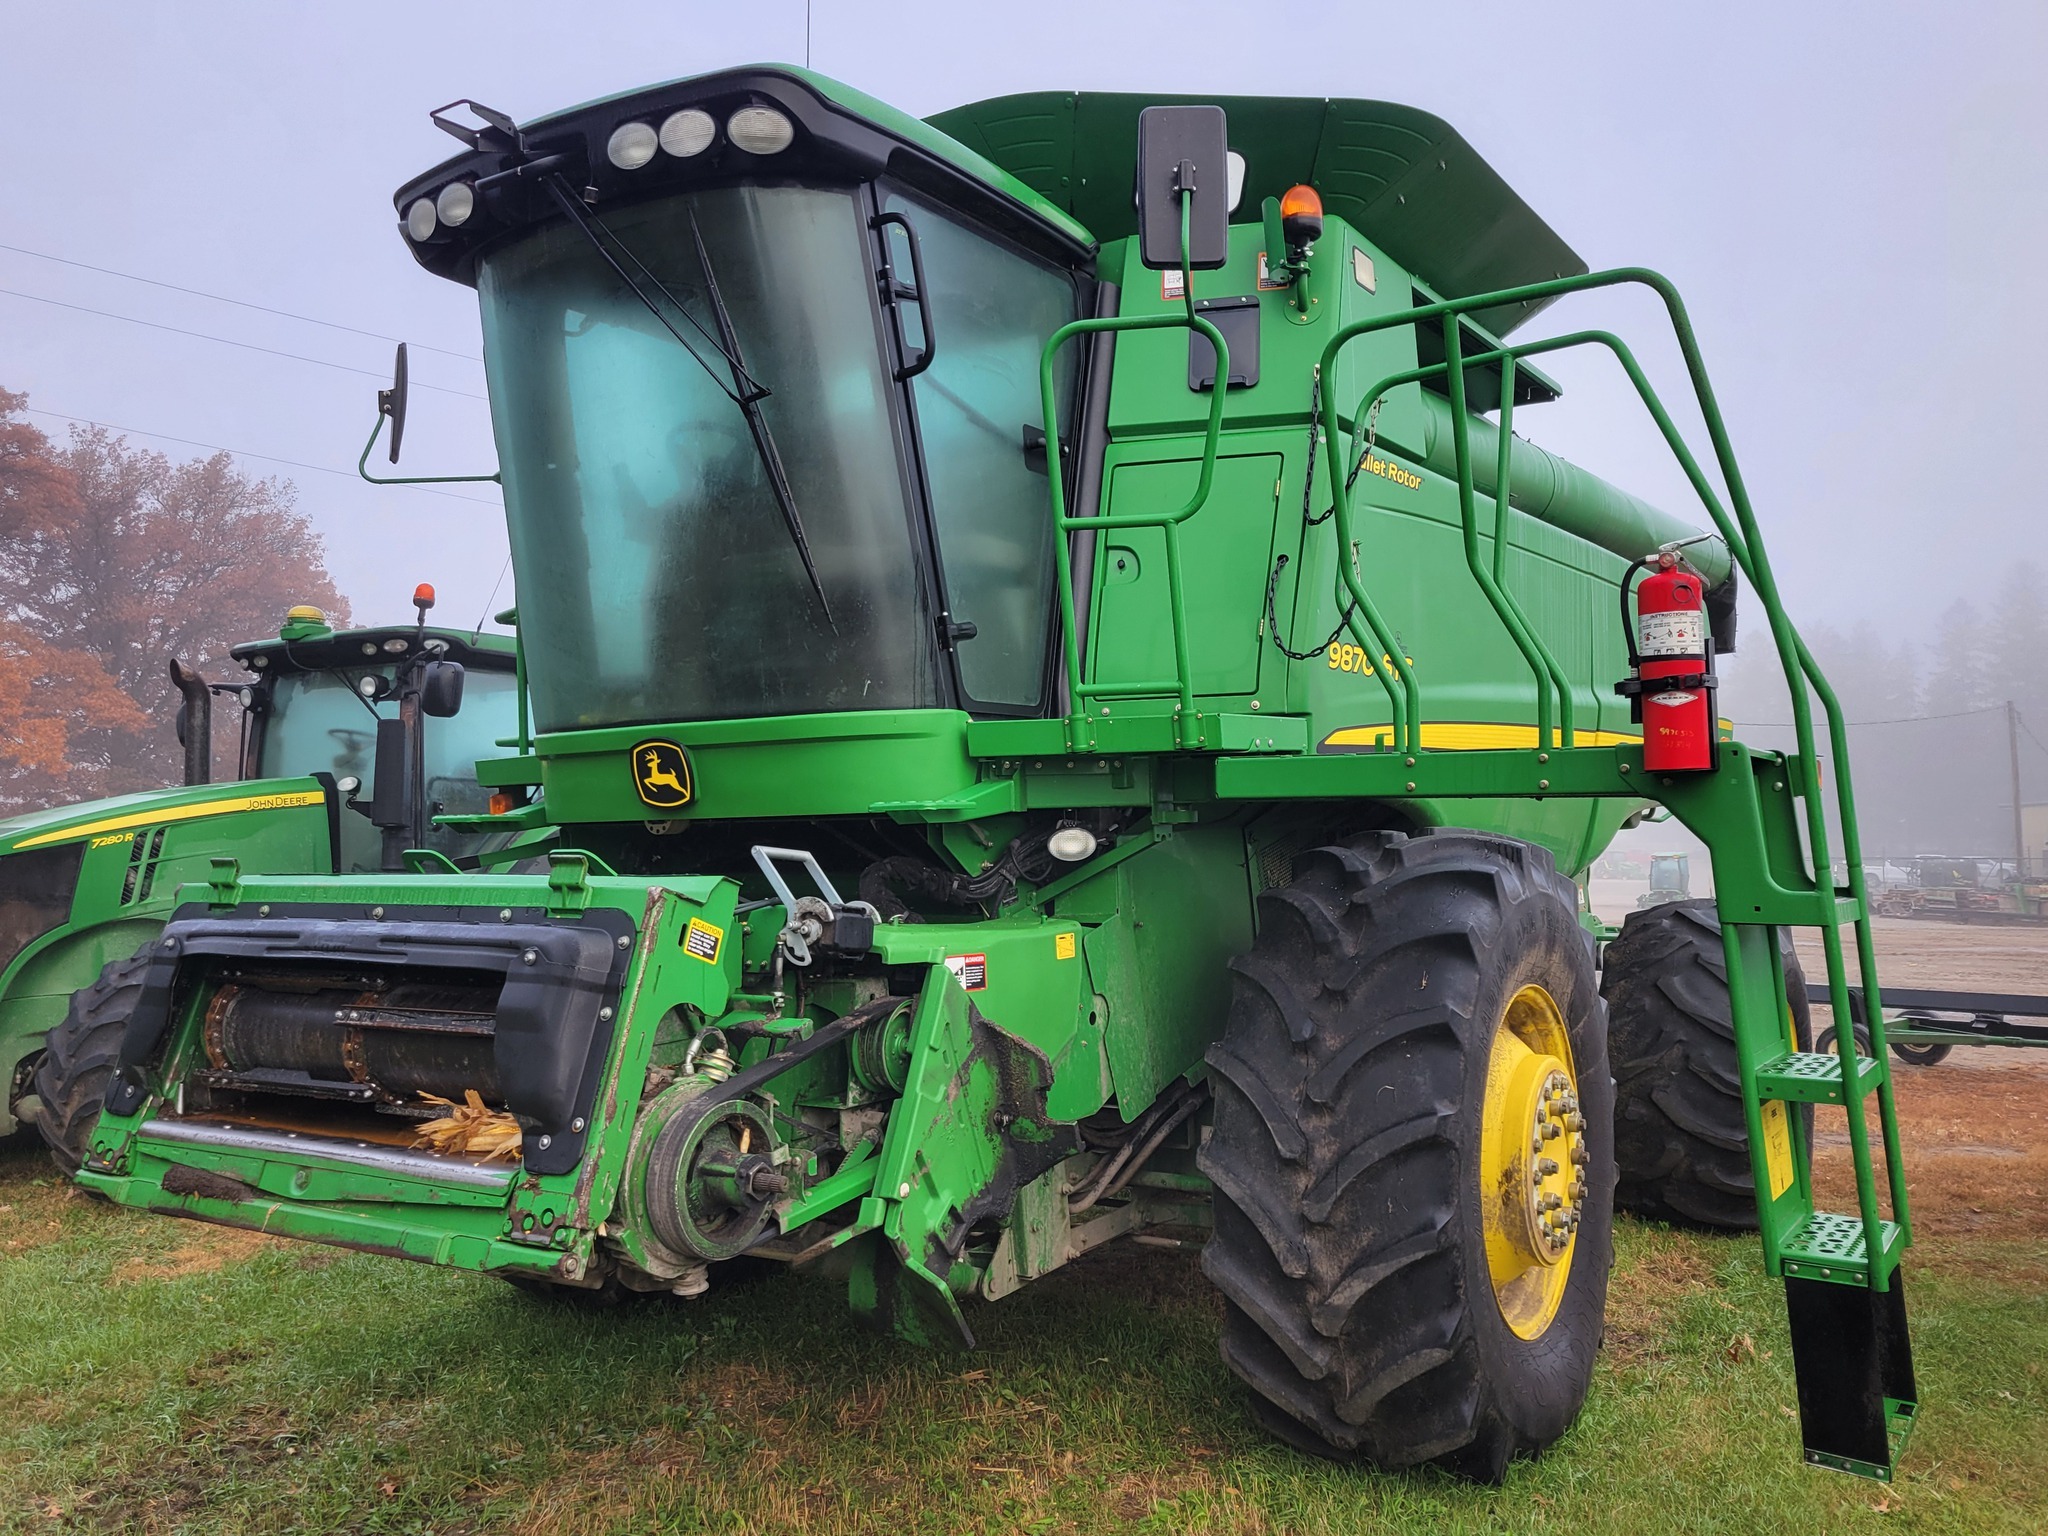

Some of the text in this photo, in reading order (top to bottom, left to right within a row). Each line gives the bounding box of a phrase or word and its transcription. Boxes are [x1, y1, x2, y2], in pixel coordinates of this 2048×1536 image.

[1388, 462, 1422, 491] Rotor
[246, 796, 308, 810] JOHN DEERE
[91, 833, 134, 849] 7280 R
[697, 921, 721, 937] CAUTION
